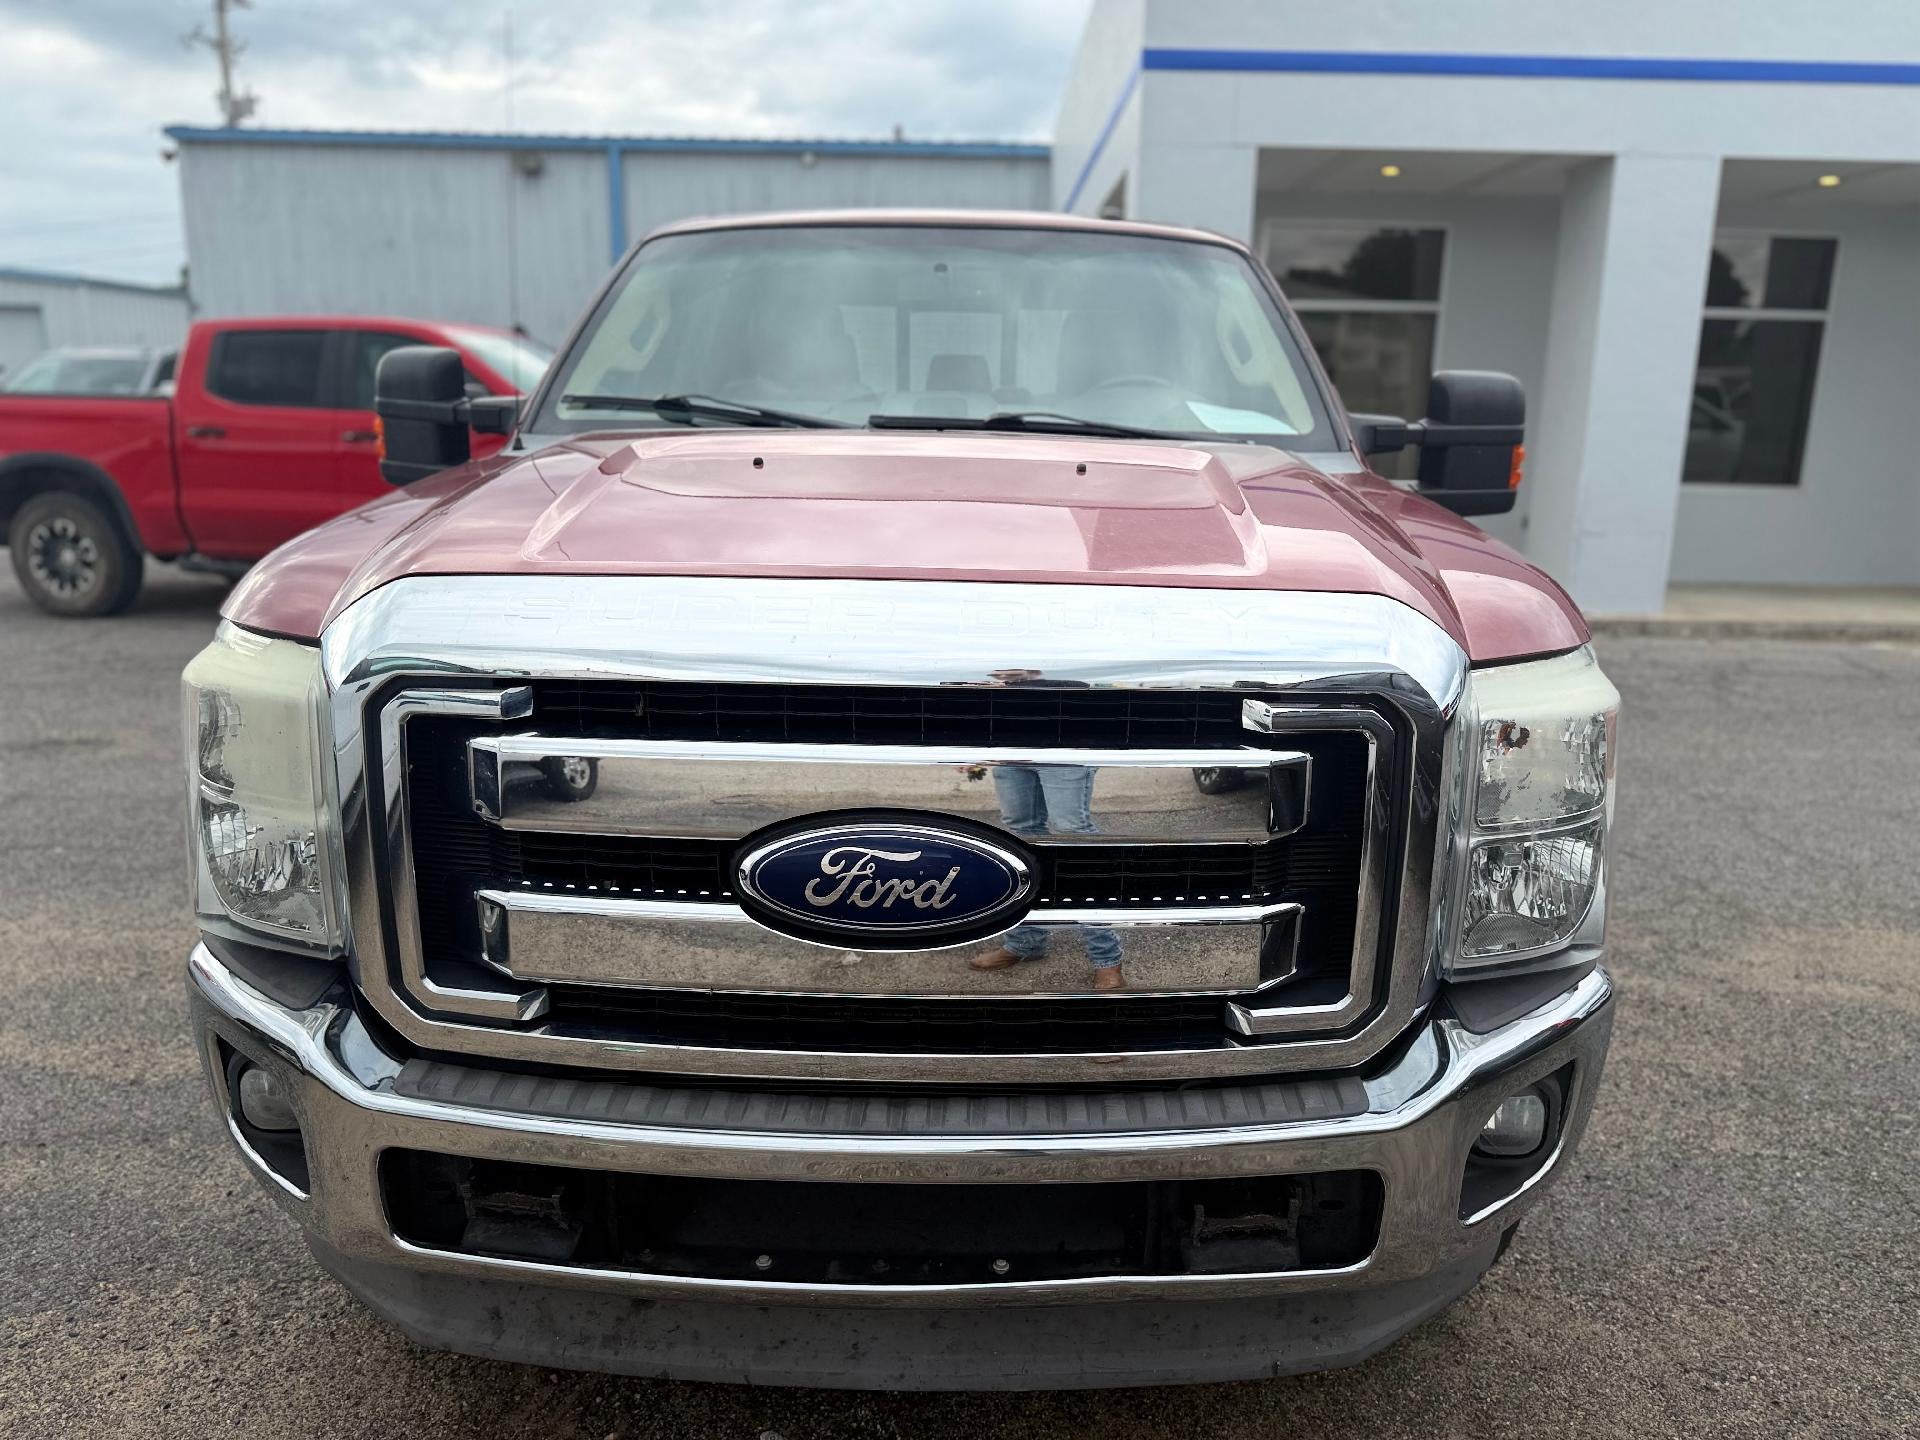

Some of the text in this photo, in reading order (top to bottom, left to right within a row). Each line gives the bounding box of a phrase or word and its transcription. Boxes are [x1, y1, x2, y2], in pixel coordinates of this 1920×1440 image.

[503, 590, 1265, 642] SUPER DUTY
[804, 846, 961, 909] Ford
